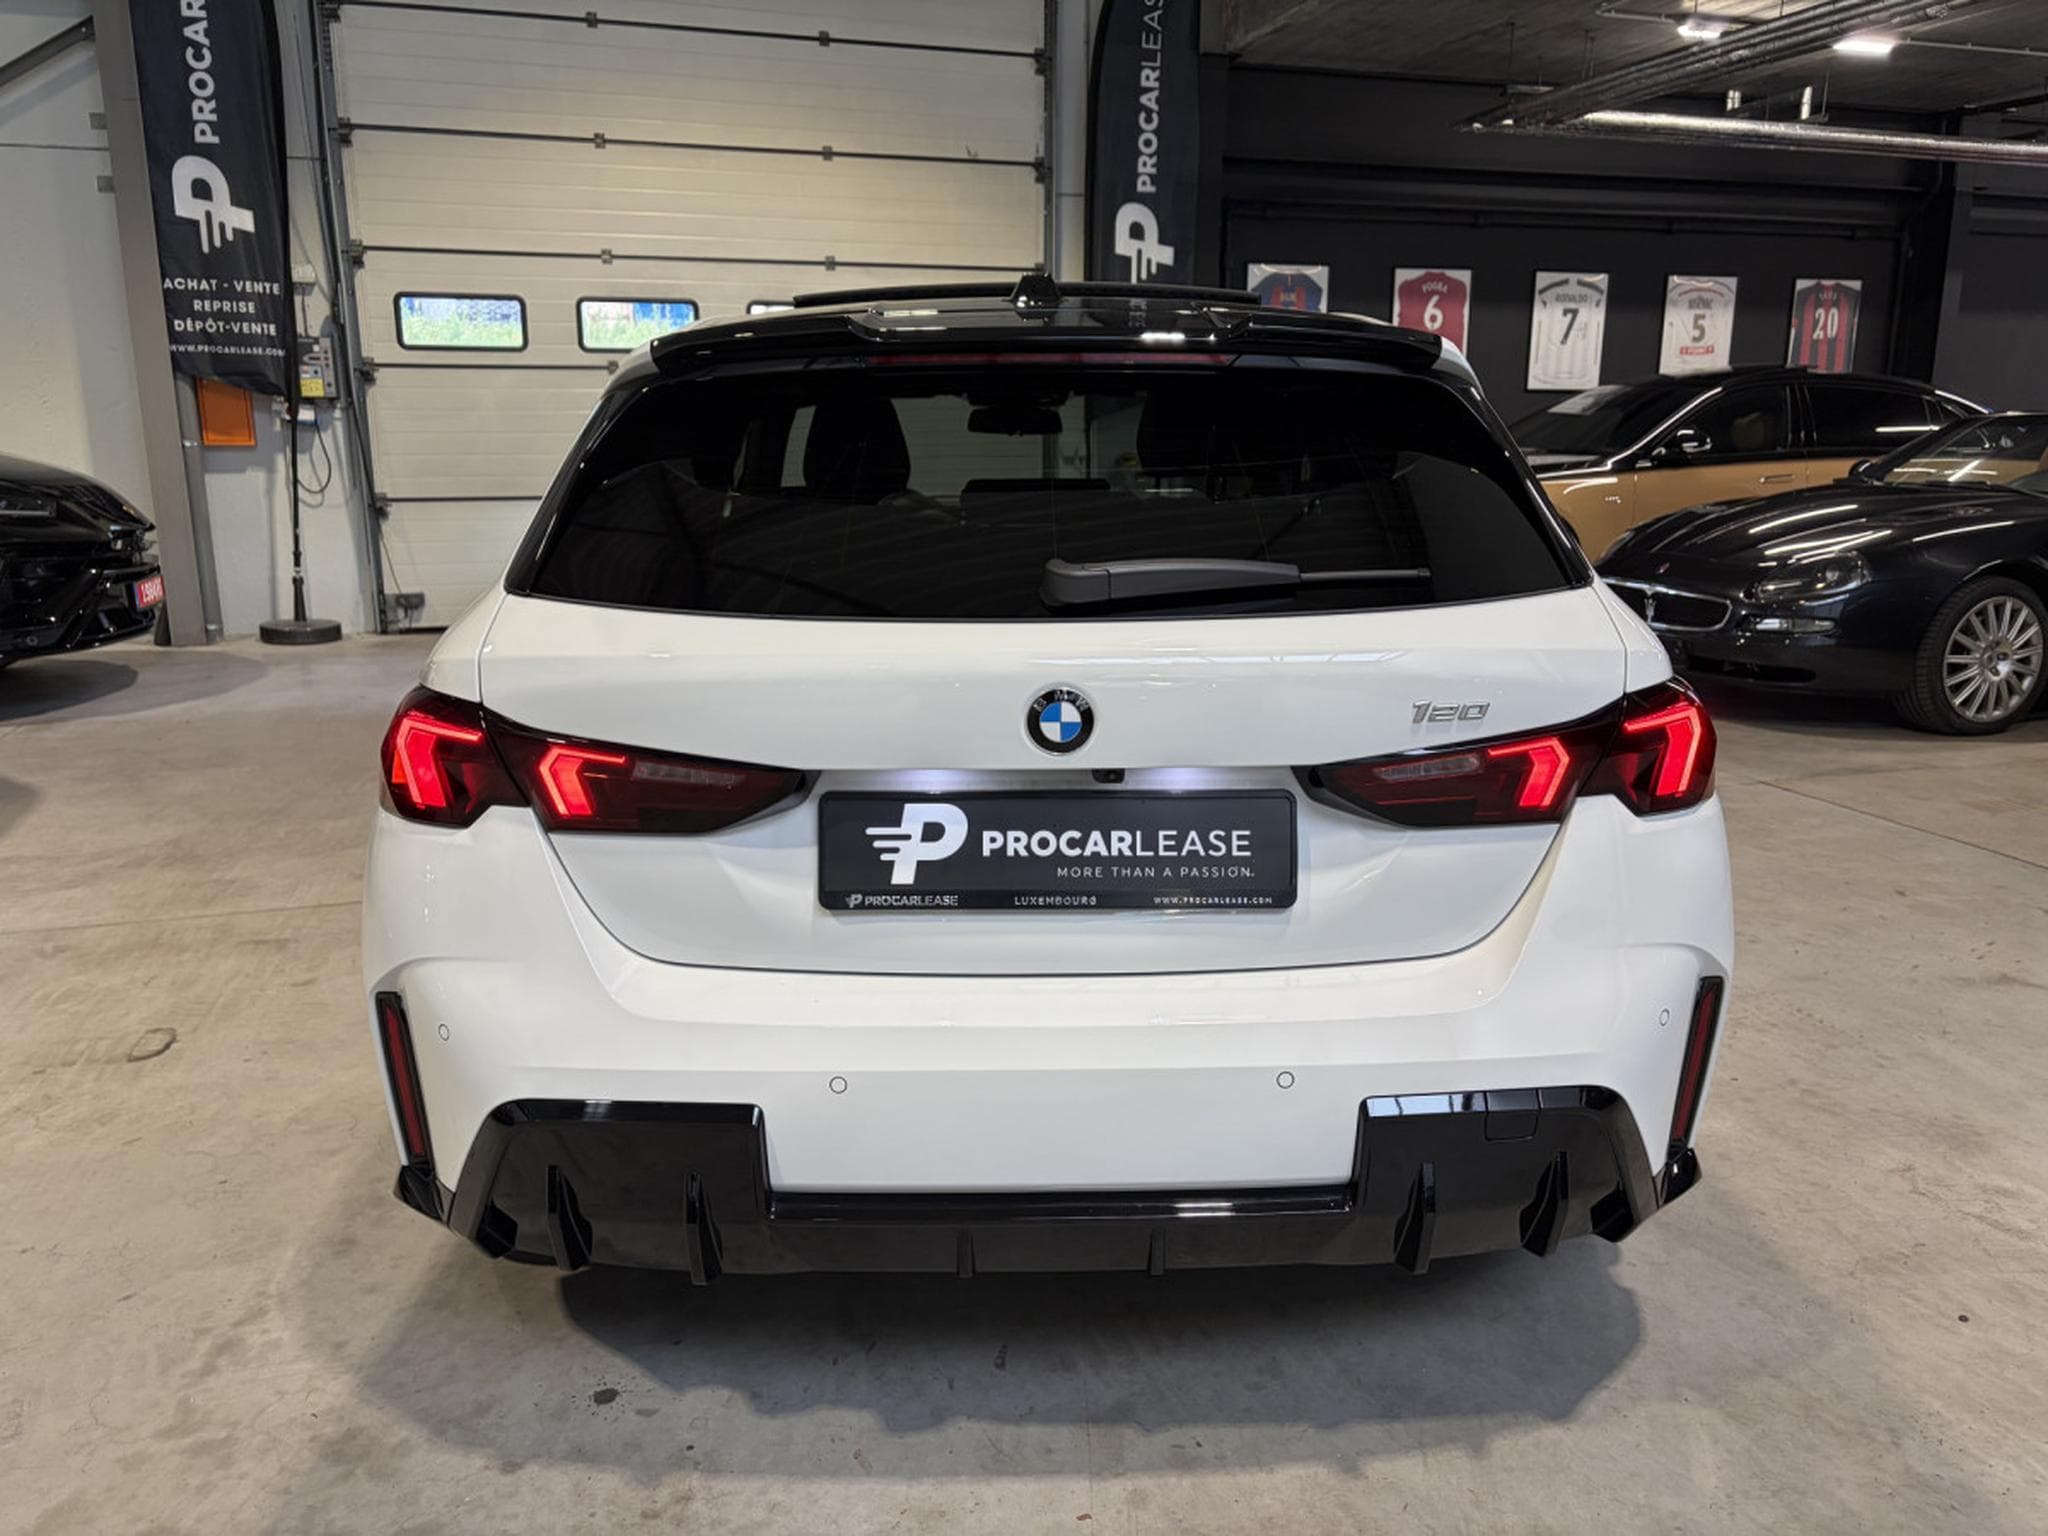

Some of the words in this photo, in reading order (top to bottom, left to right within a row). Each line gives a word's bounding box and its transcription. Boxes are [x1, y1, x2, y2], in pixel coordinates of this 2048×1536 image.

[180, 0, 220, 145] PROCAR
[163, 277, 218, 291] ACHAT
[233, 280, 281, 295] VENTE
[193, 299, 256, 314] REPRISE
[1423, 294, 1444, 331] 6
[1560, 308, 1579, 346] 7
[1692, 312, 1706, 343] 5
[1812, 307, 1839, 340] 20
[1033, 688, 1090, 712] BMW
[1412, 700, 1491, 724] 120
[982, 830, 1252, 857] PROCARLEASE
[1057, 866, 1104, 878] MORE
[1111, 867, 1155, 878] THAN
[1163, 867, 1173, 878] A
[864, 895, 959, 906] PROCARLEASE
[1014, 895, 1097, 906] LUXEMBOURG
